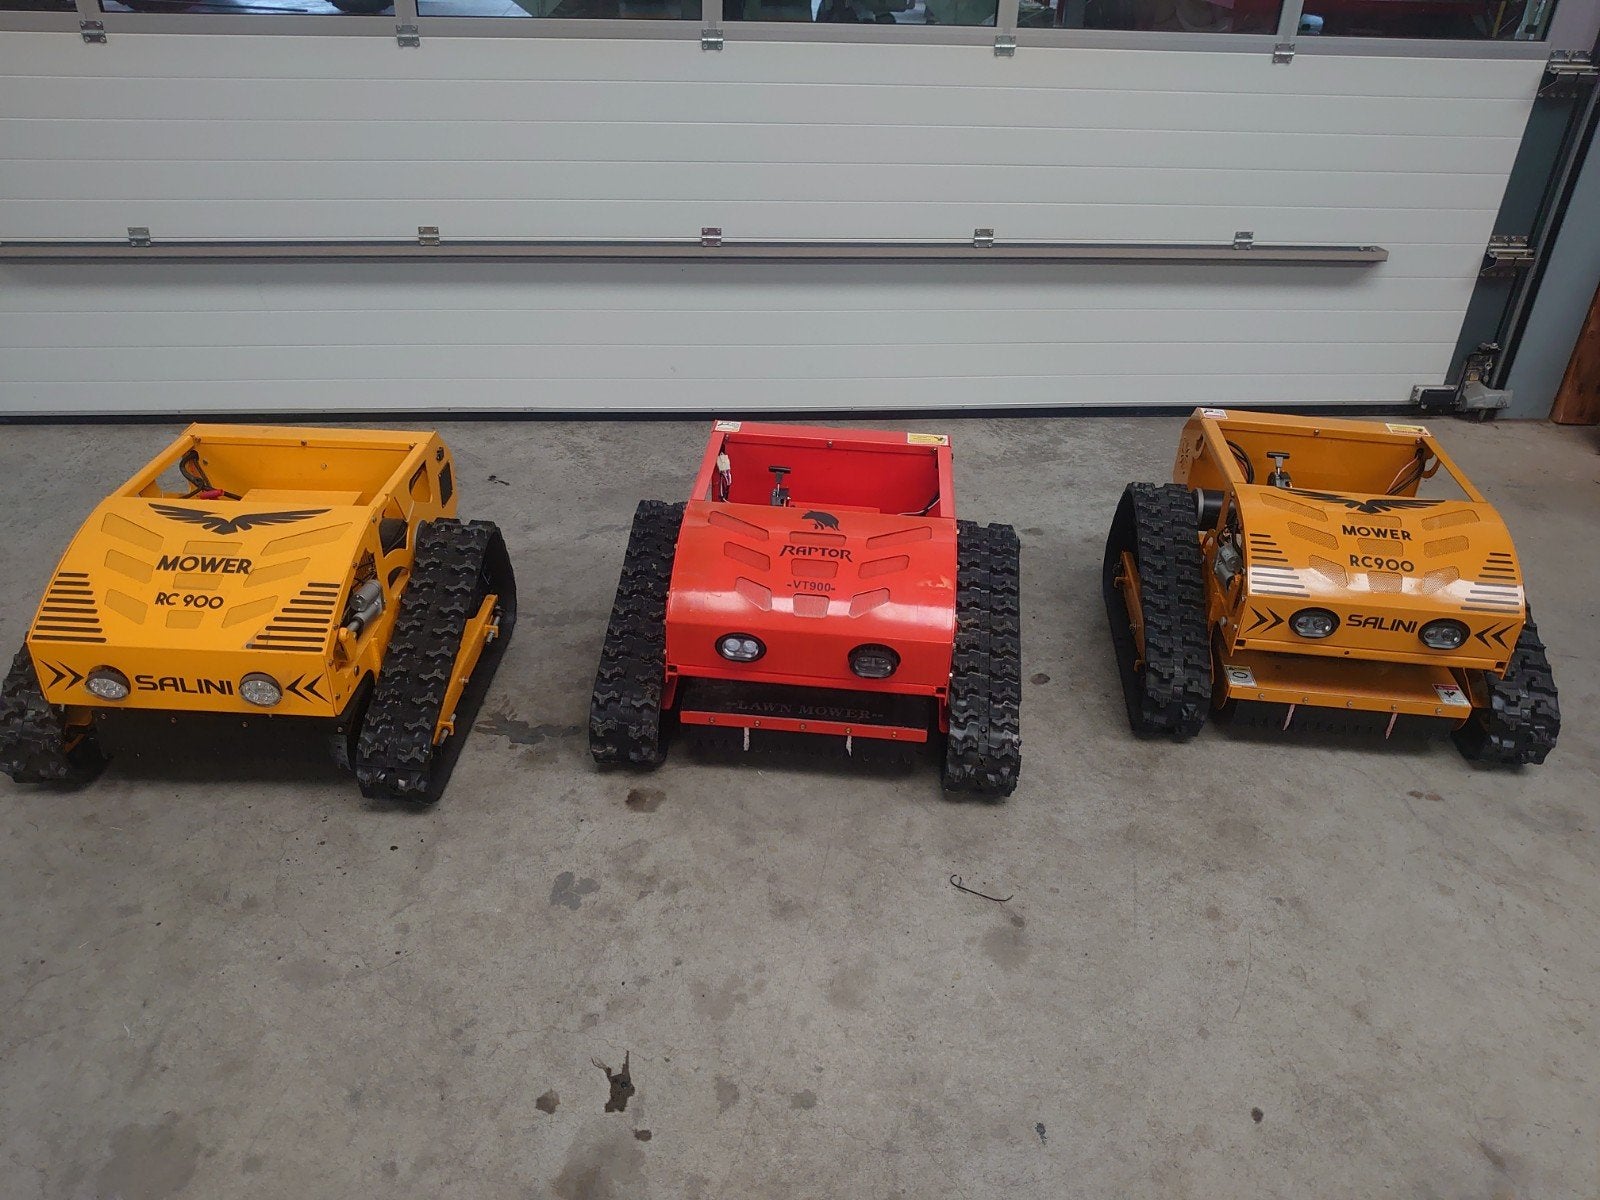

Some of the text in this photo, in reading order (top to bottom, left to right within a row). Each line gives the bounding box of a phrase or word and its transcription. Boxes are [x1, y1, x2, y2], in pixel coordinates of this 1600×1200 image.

[1342, 524, 1413, 541] MOWER
[779, 545, 853, 562] RAPTOR
[155, 555, 252, 575] MOWER
[1349, 554, 1415, 573] RC900
[155, 592, 224, 610] RC 900
[1345, 614, 1418, 634] SALINI
[134, 674, 234, 696] SALINI
